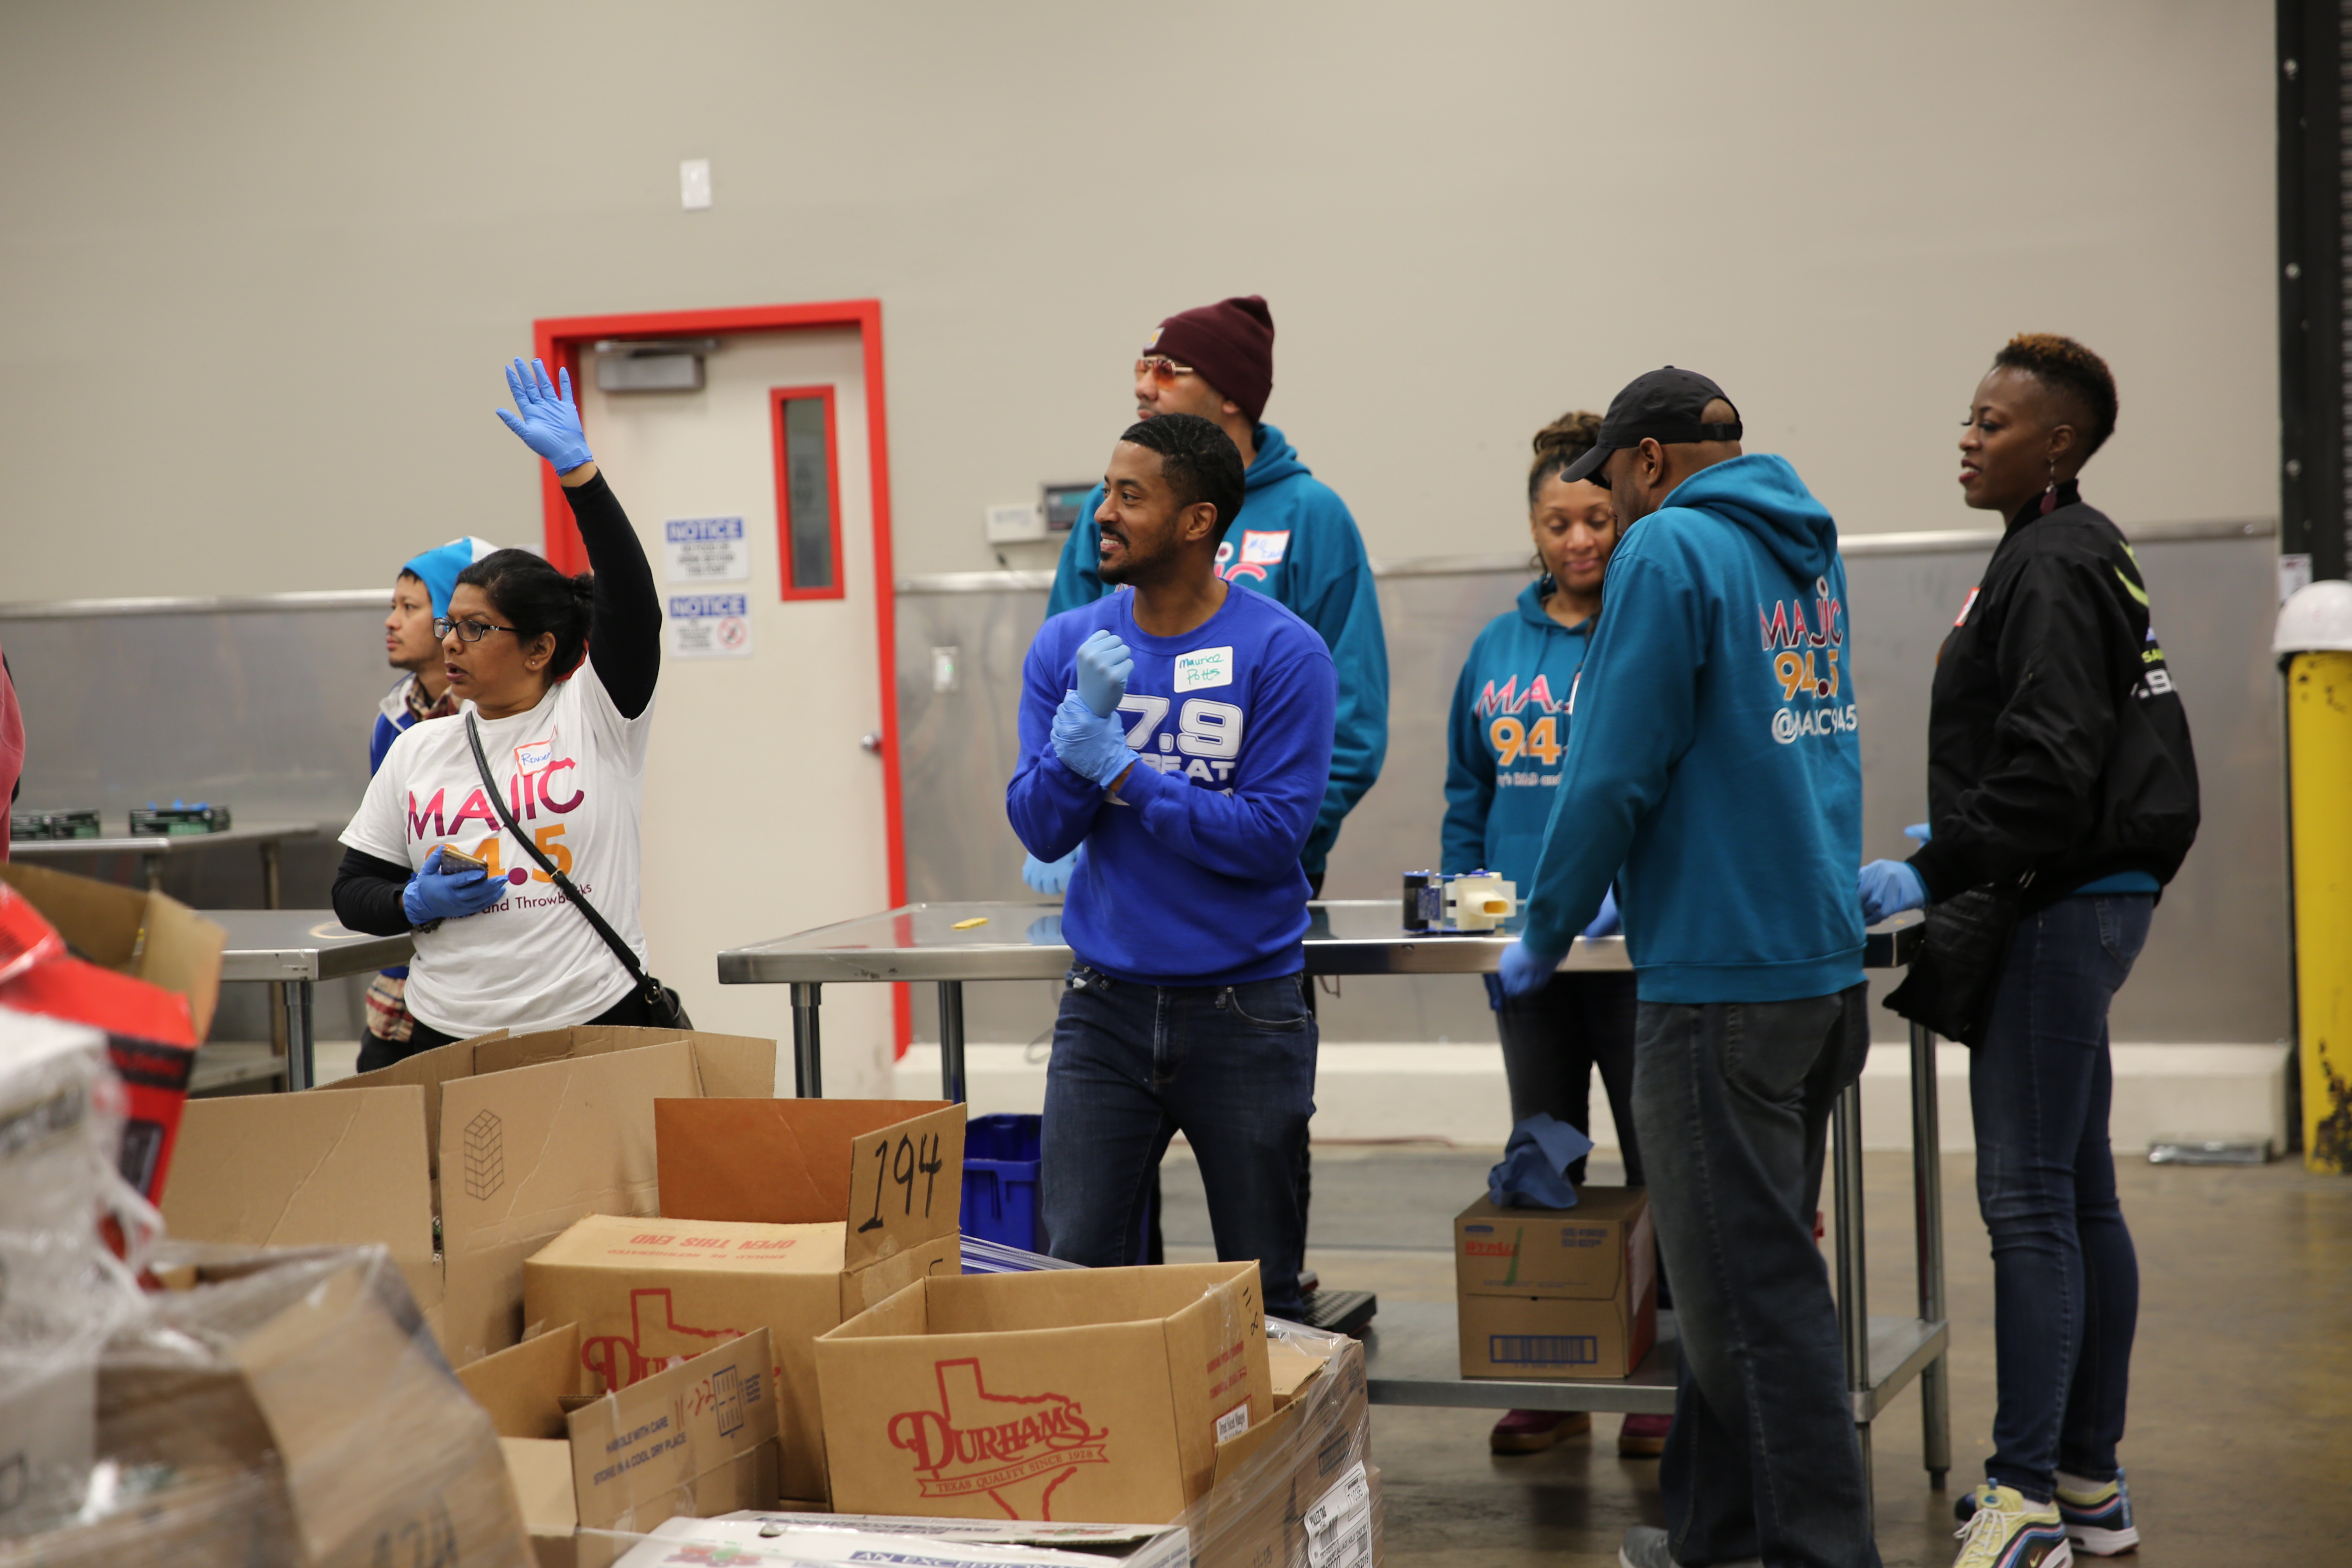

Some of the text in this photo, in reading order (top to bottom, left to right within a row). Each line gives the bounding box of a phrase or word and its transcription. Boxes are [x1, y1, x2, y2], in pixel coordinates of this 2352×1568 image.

[668, 518, 739, 540] NOTICE
[672, 596, 743, 616] NOTICE
[1758, 575, 1843, 651] MAJIC
[1774, 649, 1839, 702] 94.5
[1067, 689, 1243, 760] 7.9
[408, 757, 584, 844] MAJIC
[425, 824, 572, 885] 4.5
[515, 884, 592, 910] Throwbks
[858, 1132, 942, 1233] 194
[607, 1250, 701, 1258] REFRIGERATED
[630, 1234, 797, 1250] OPEN THIS END
[606, 1415, 669, 1454] HANDLE WITH CARE
[594, 1466, 616, 1486] STORE
[631, 1450, 650, 1468] COOL
[665, 1432, 687, 1450] PLACE
[937, 1450, 1094, 1493] TEXAS QUALITY SINCE 1928
